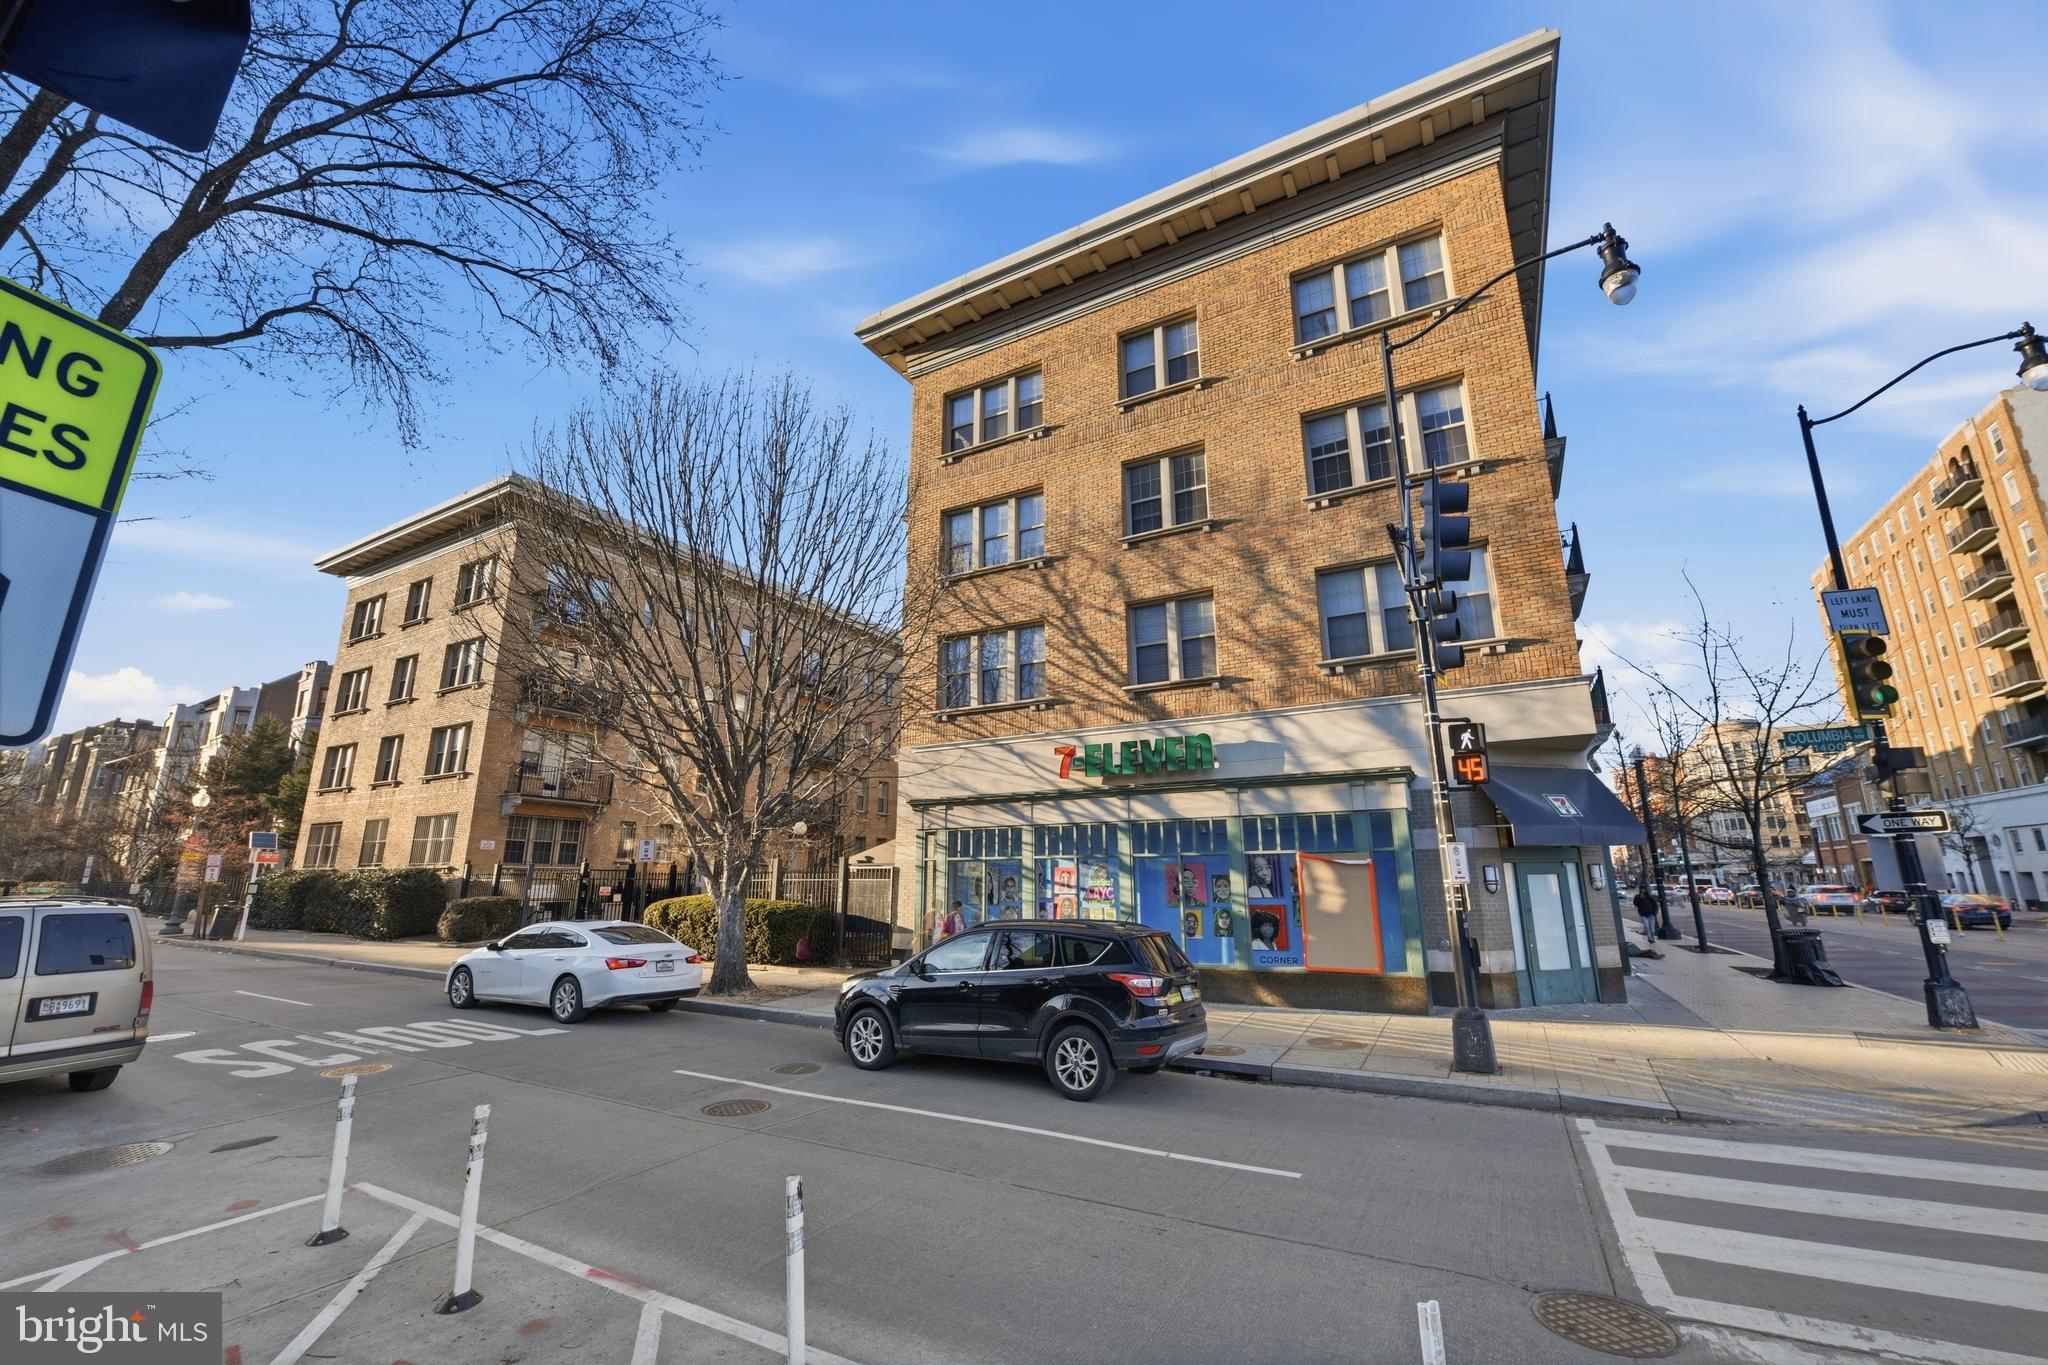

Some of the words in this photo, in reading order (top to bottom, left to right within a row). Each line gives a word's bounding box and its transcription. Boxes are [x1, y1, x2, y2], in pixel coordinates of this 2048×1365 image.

[1830, 597, 1849, 606] LEFT
[1851, 595, 1873, 604] LANE
[1840, 608, 1870, 618] MUST
[1788, 728, 1853, 744] COLUMBIA
[1458, 758, 1484, 780] 45
[1883, 819, 1908, 828] ONE
[1911, 816, 1936, 826] WAY
[1260, 955, 1298, 965] CORNER
[173, 1018, 572, 1079] SCHOOL
